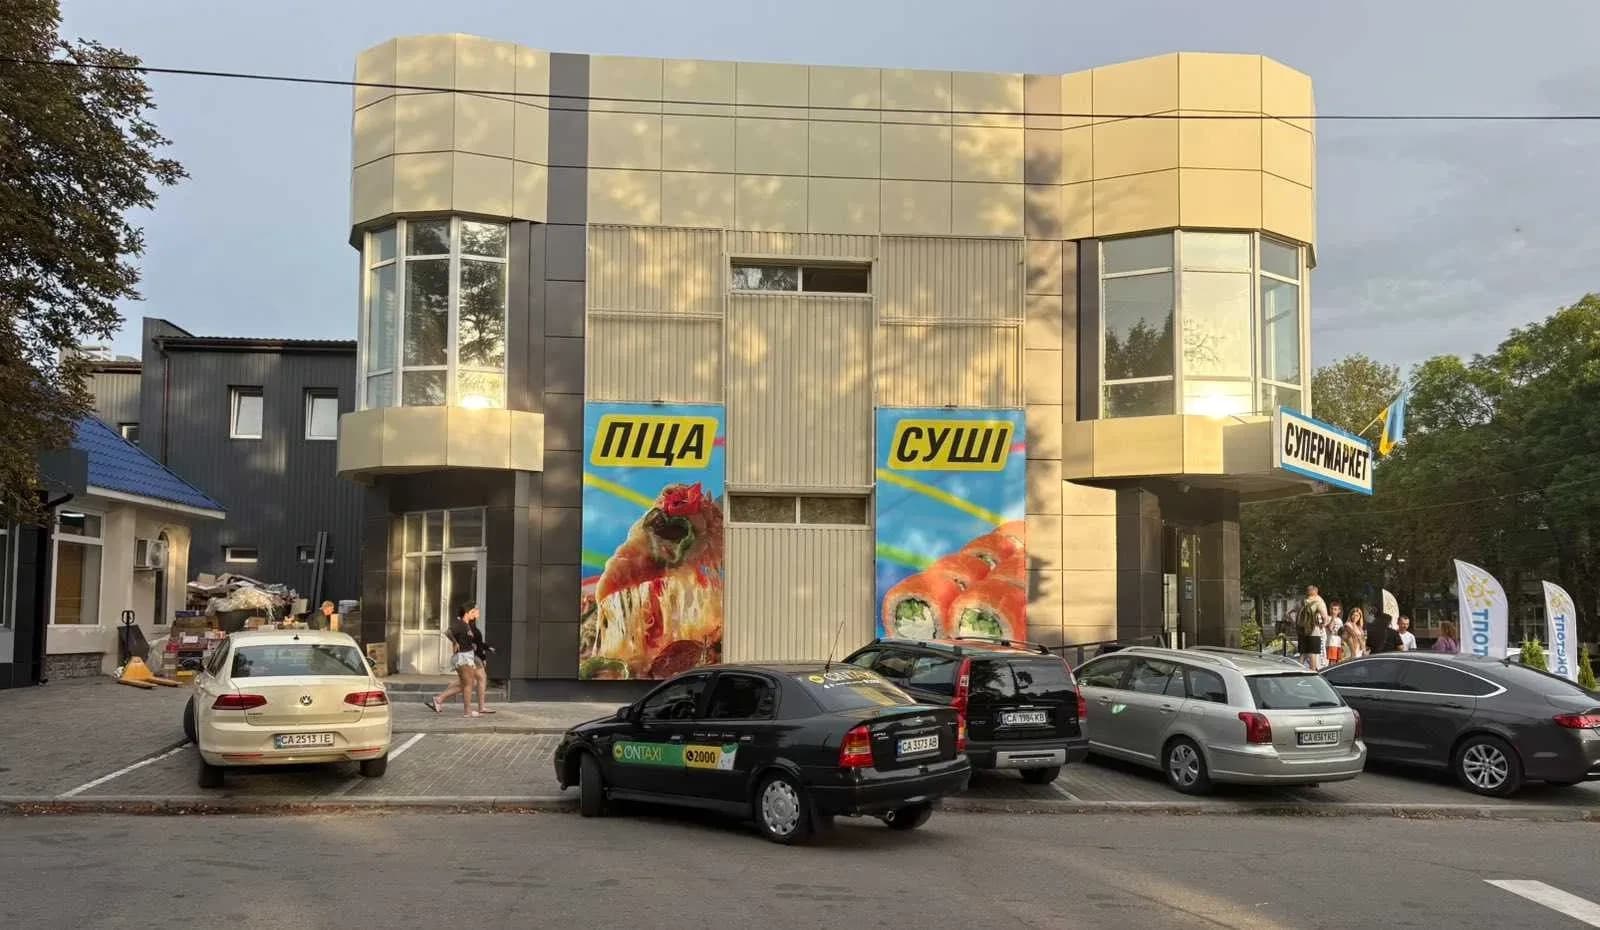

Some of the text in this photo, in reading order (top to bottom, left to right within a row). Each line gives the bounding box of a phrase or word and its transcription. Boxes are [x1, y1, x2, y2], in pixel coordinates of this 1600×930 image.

[600, 421, 705, 467] ПІЦА
[896, 426, 1009, 464] СУШІ
[1284, 422, 1369, 481] СУПЕРМАРКЕТ
[1006, 714, 1017, 722] CA
[281, 735, 294, 745] CA
[902, 741, 913, 752] CA
[623, 744, 663, 761] ONTAXI
[693, 750, 716, 764] 2000
